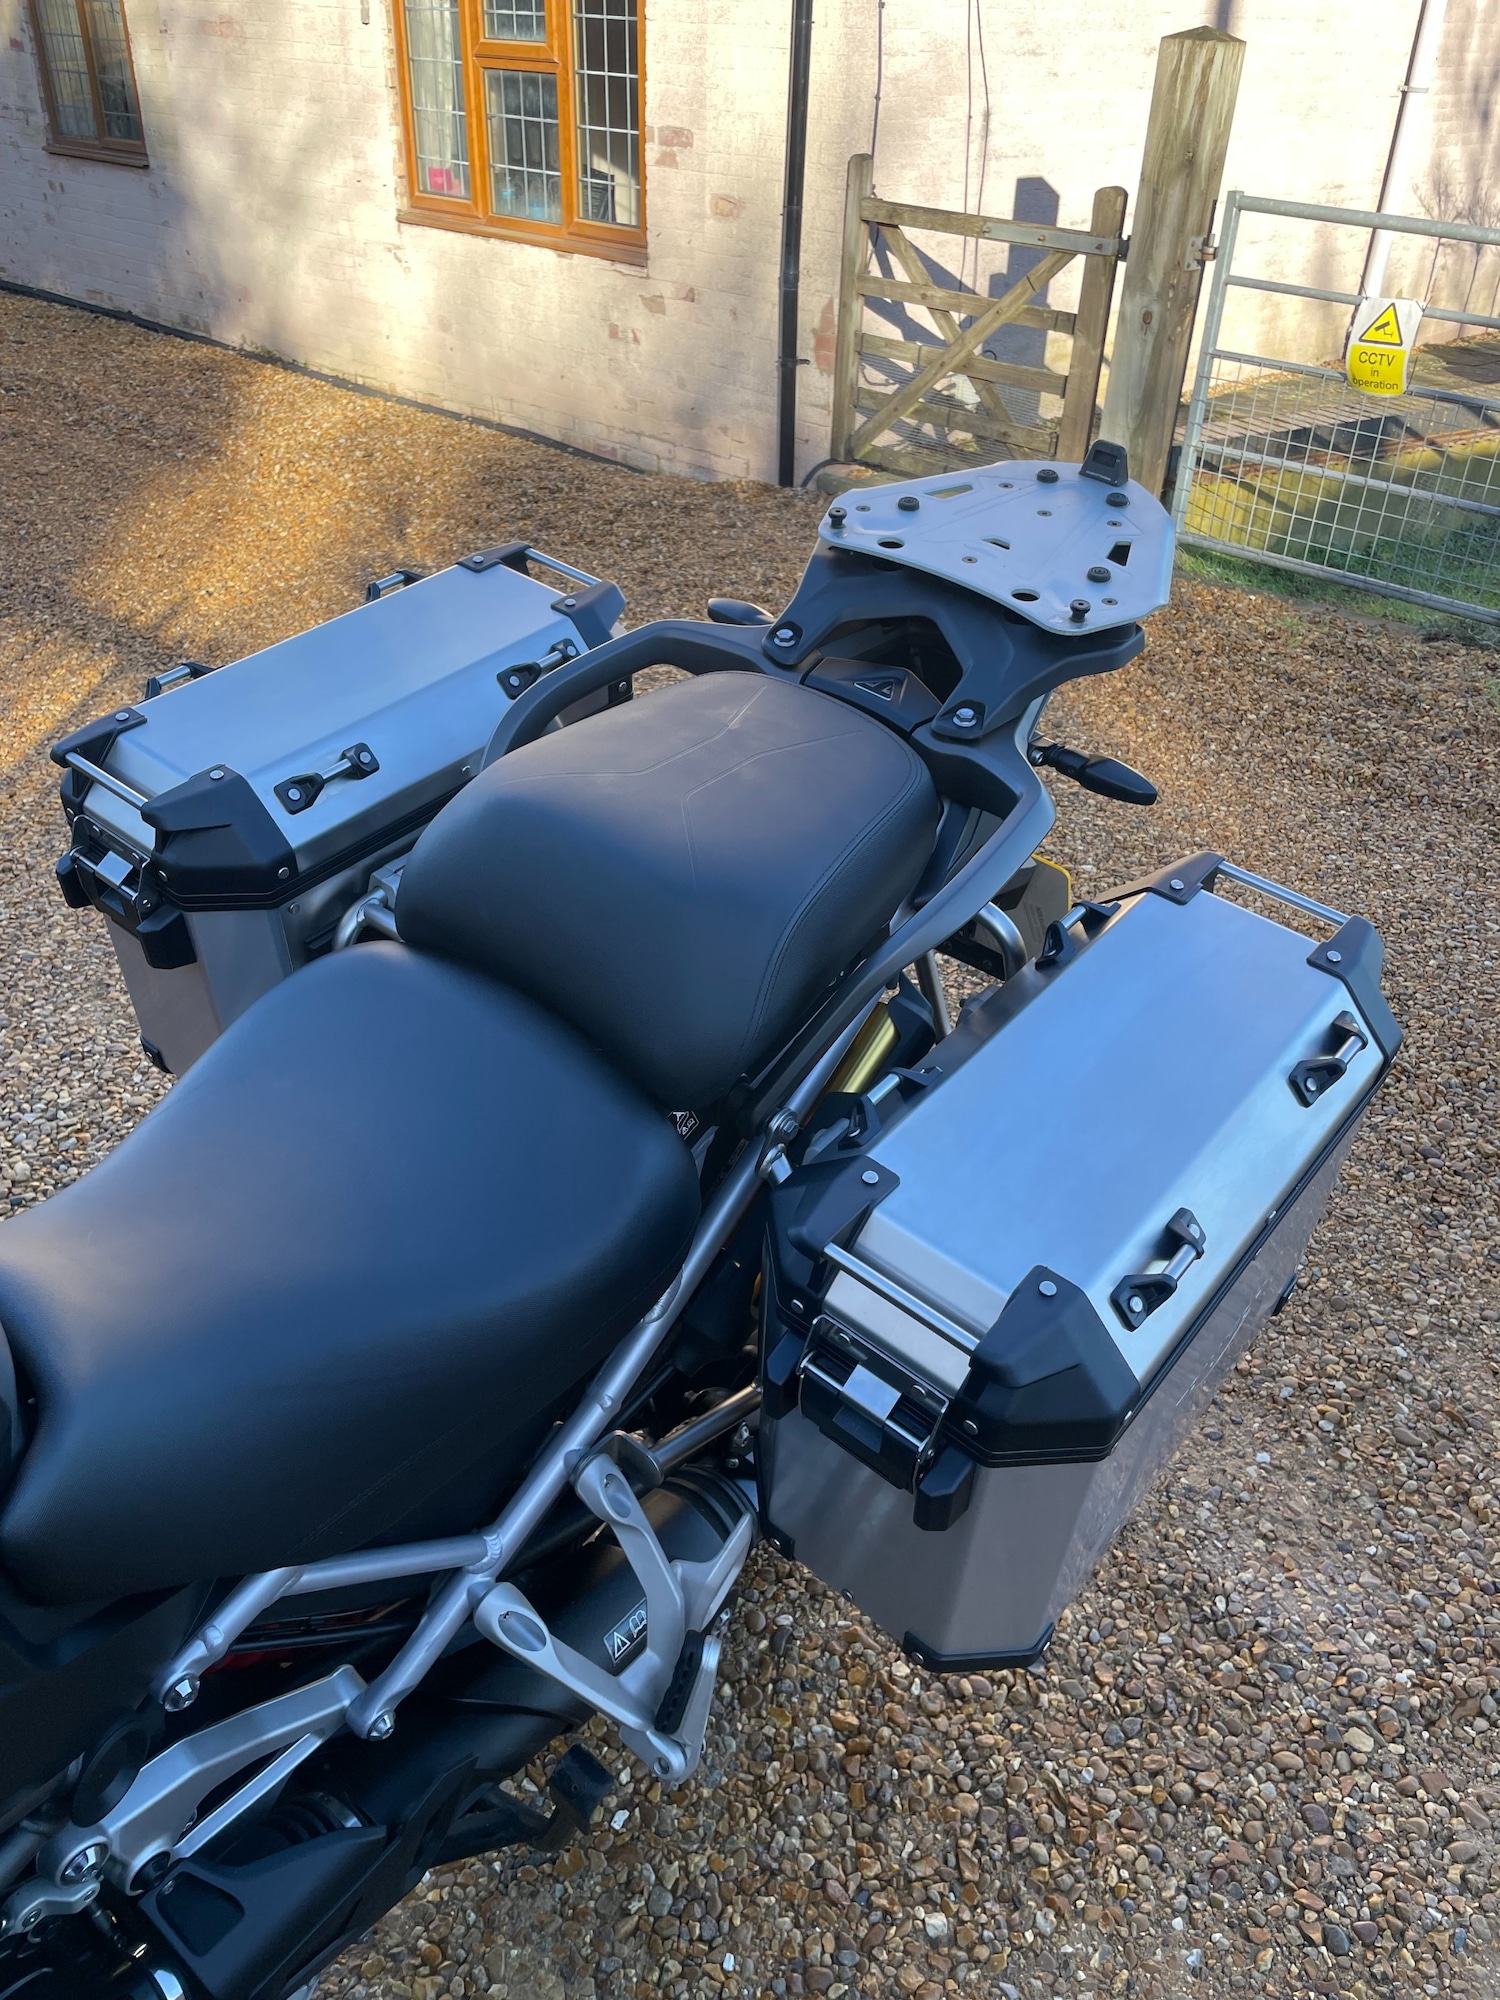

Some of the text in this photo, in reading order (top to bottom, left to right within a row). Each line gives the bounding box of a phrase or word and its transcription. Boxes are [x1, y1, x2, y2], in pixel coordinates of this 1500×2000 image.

[1358, 351, 1396, 367] CCTV
[1370, 367, 1379, 377] in
[1352, 377, 1399, 390] operation
